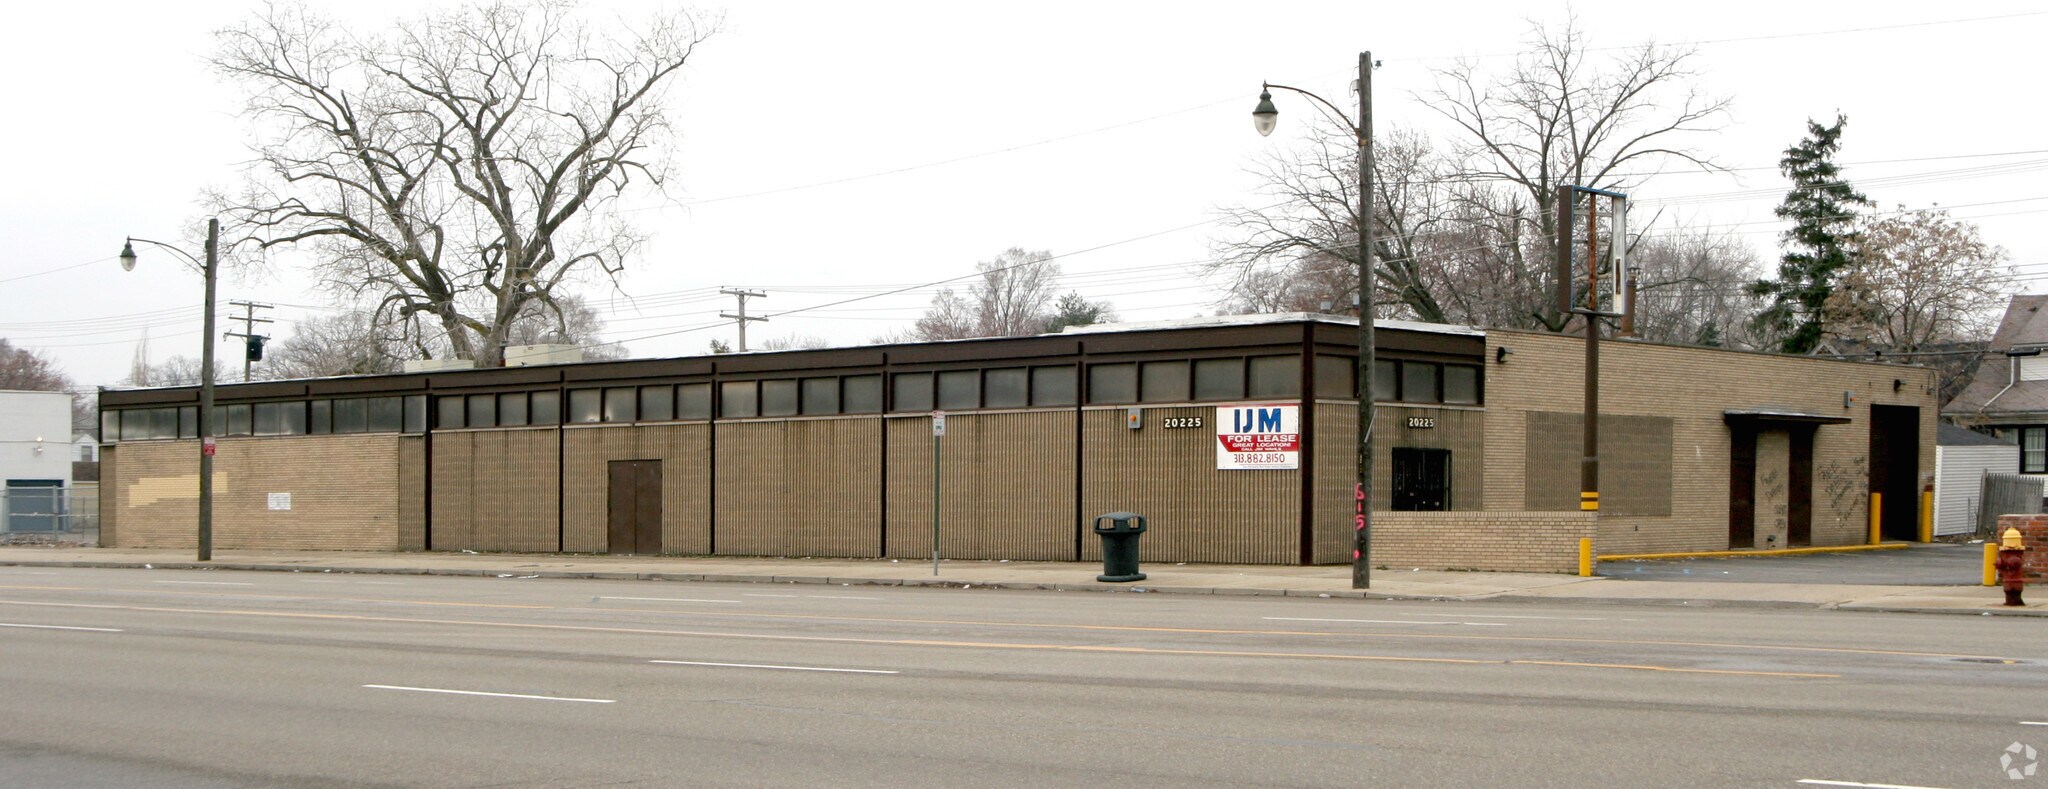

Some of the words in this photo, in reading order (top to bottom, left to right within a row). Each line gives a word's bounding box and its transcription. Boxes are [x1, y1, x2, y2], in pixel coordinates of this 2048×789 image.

[1164, 417, 1202, 428] 20225
[1234, 408, 1281, 433] IJM
[1409, 417, 1434, 427] 20225
[1227, 435, 1252, 443] FOR
[1257, 434, 1297, 442] LEASE
[1234, 454, 1286, 463] 313.882.8150
